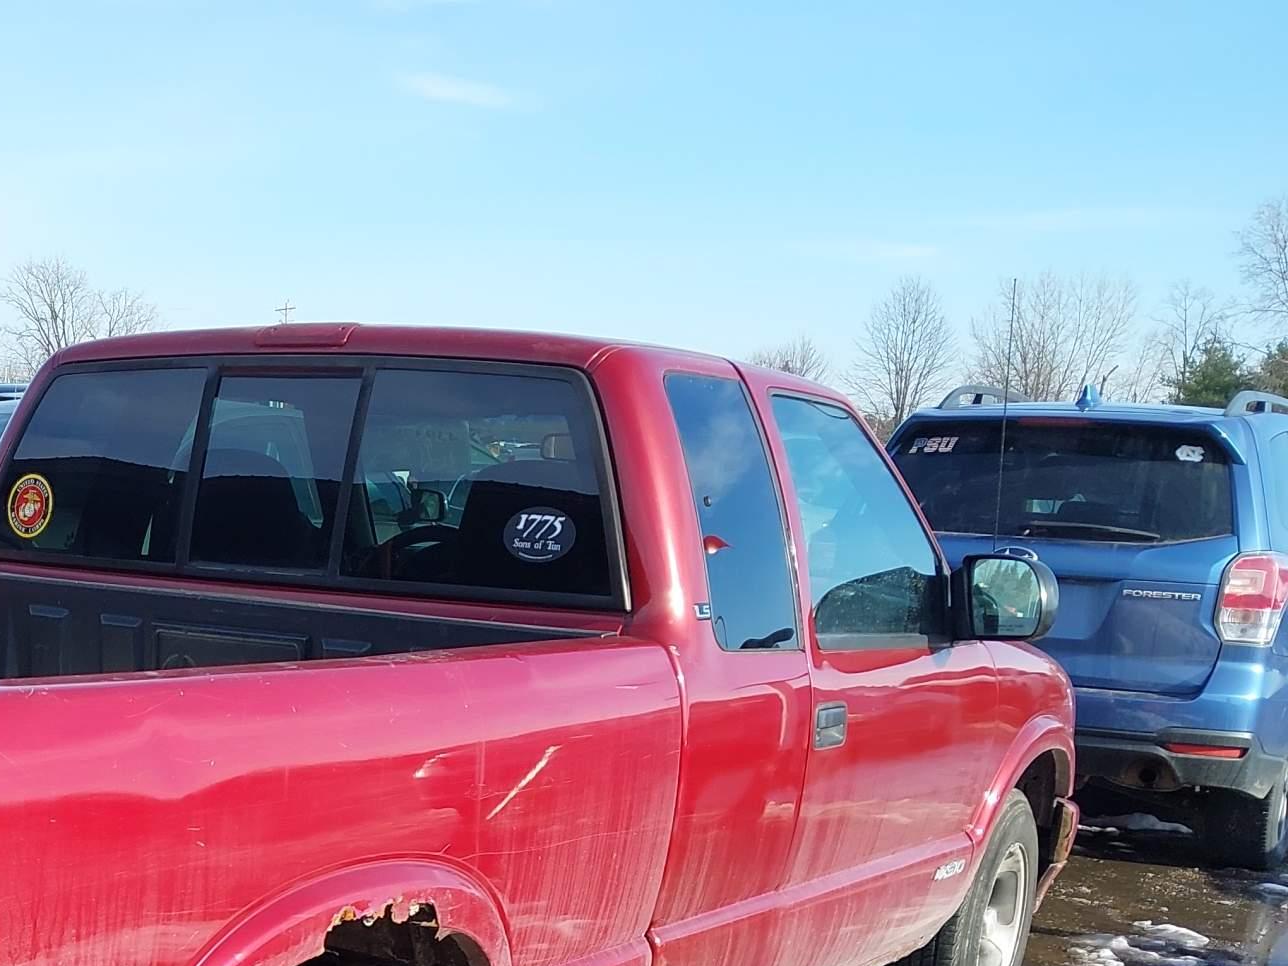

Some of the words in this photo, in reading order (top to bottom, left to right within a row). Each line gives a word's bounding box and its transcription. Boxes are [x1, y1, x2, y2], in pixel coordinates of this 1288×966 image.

[909, 436, 960, 454] PSU
[515, 513, 566, 540] 1775
[513, 538, 532, 549] Sons
[533, 540, 545, 550] of
[1122, 589, 1202, 601] FORESTER
